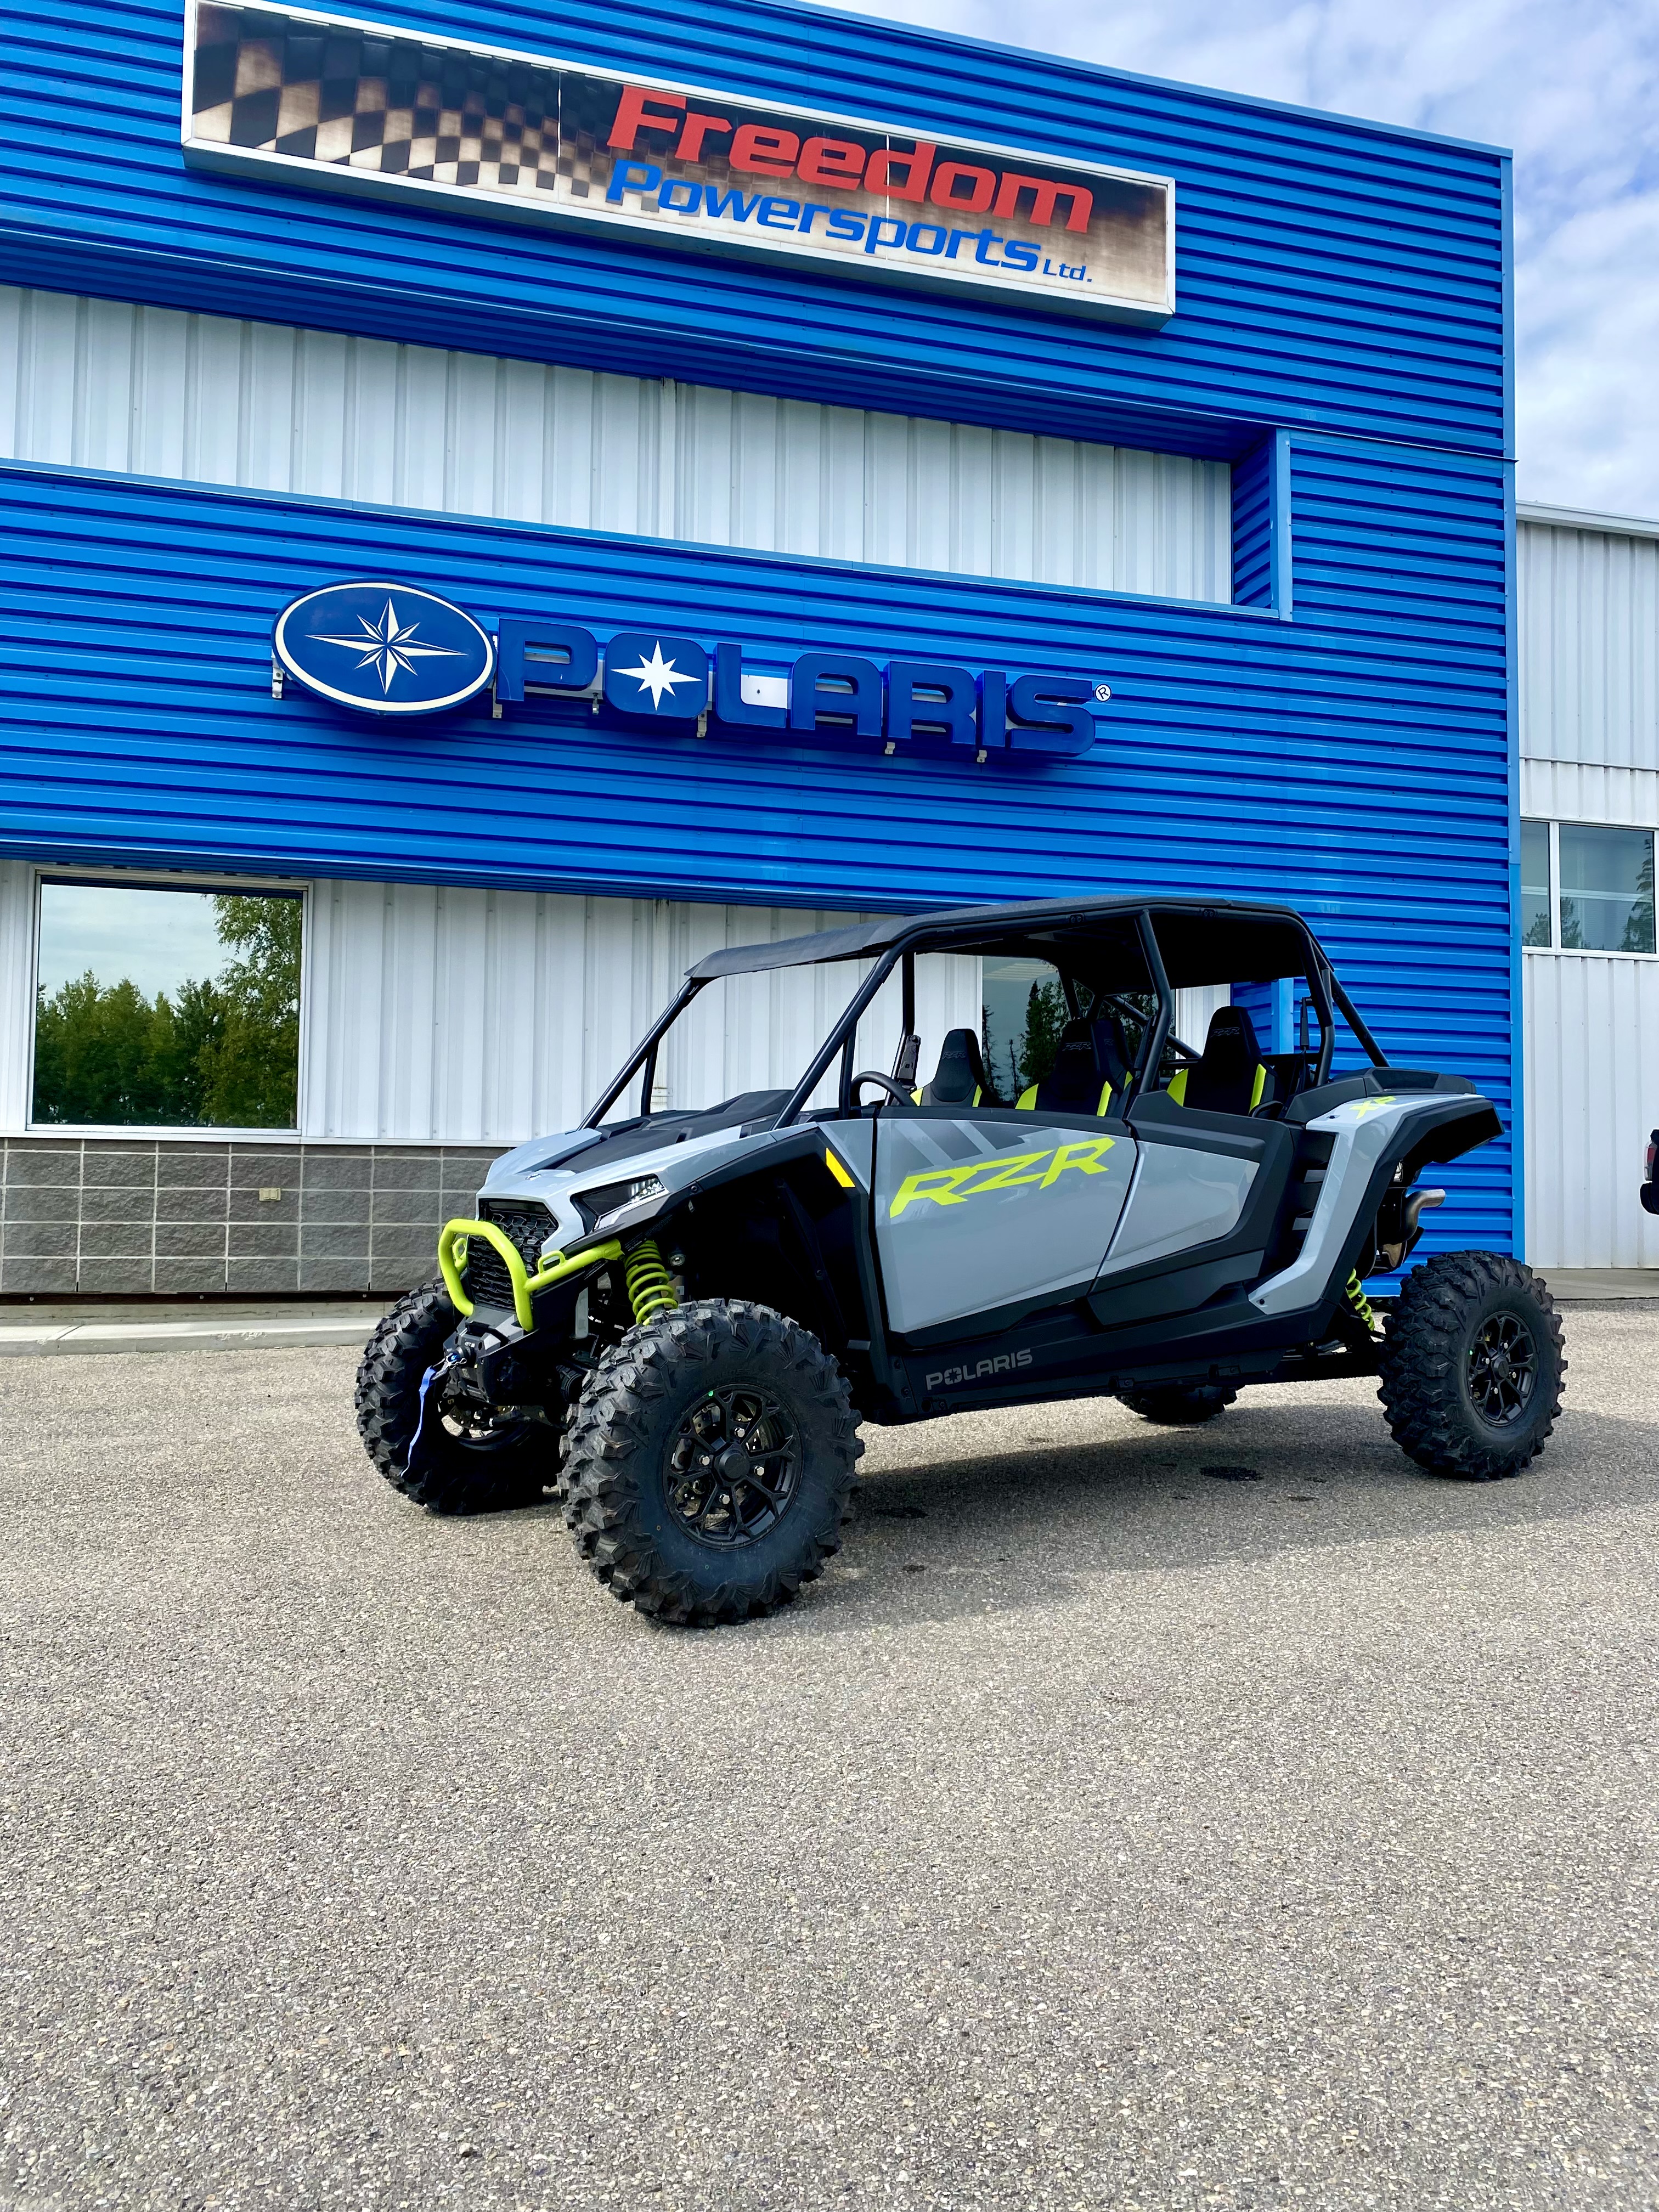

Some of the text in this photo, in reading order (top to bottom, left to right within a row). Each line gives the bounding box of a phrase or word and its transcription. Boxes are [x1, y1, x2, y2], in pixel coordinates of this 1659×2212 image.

[607, 84, 1094, 234] Freedom
[606, 159, 1092, 283] Powersports Ltd.
[496, 618, 1096, 758] POLARIS
[1348, 1096, 1397, 1120] XP
[889, 1137, 1116, 1219] RZR
[925, 1348, 1033, 1391] POLARIS
